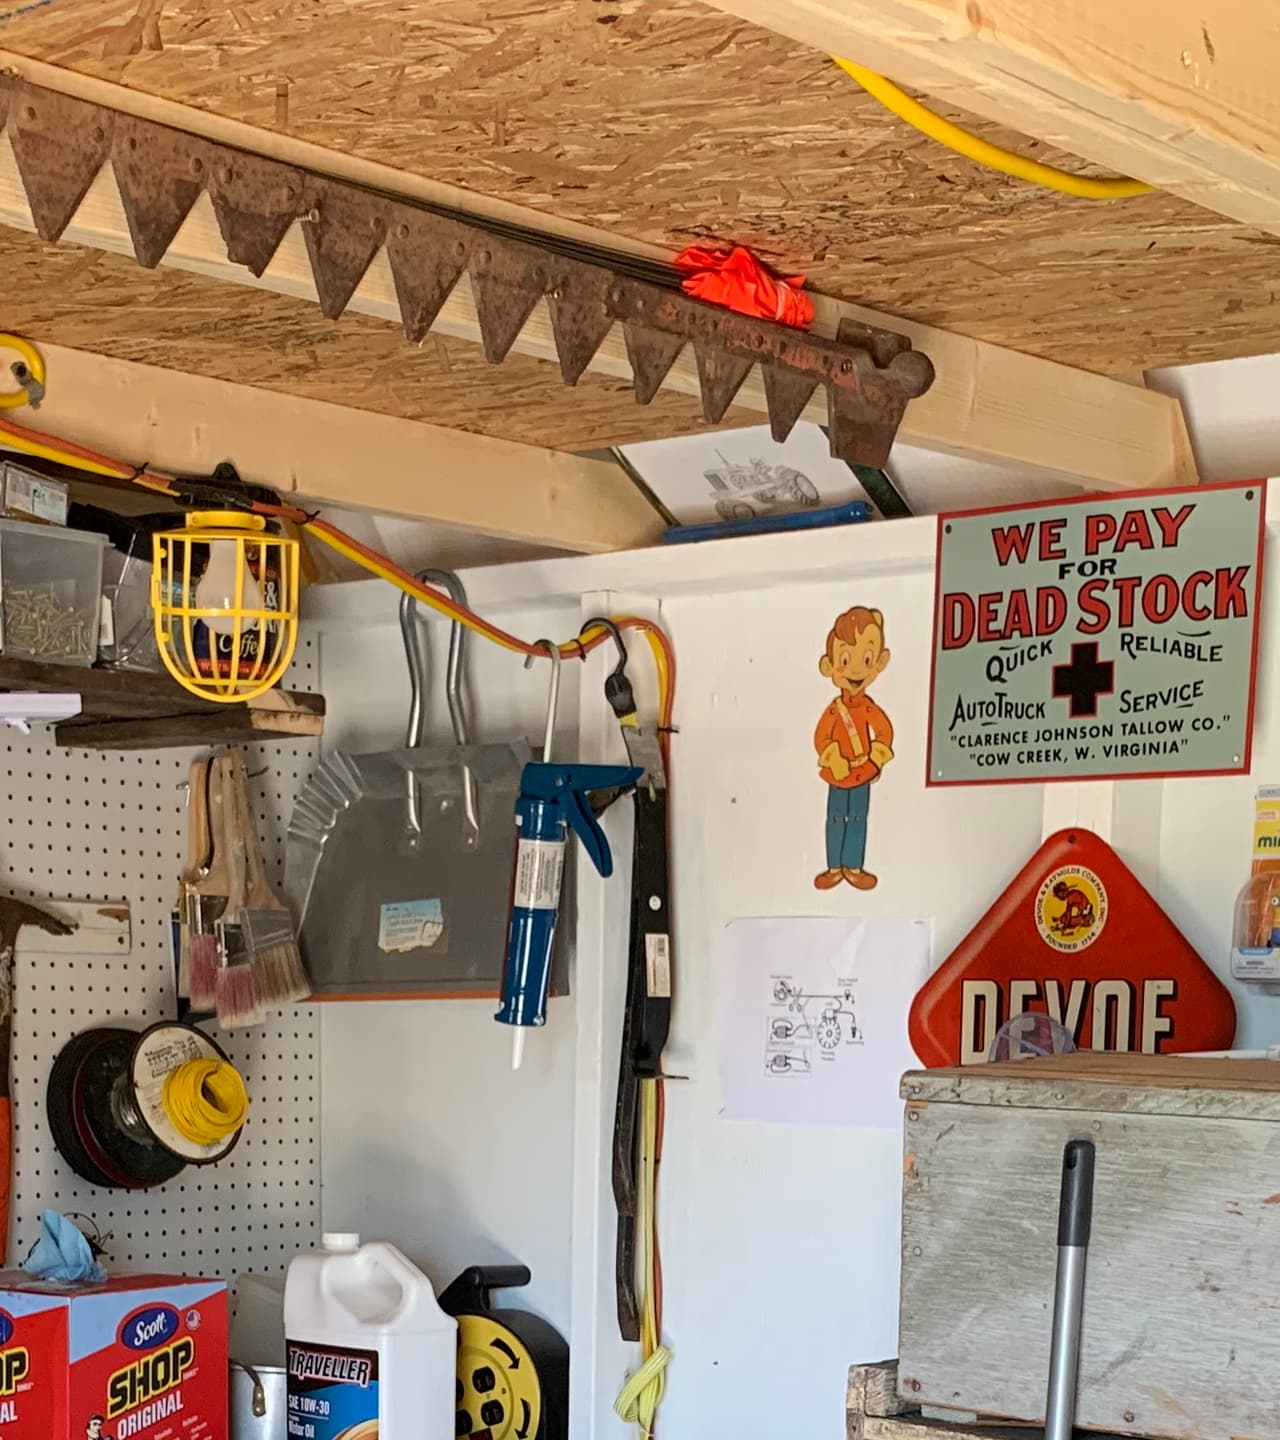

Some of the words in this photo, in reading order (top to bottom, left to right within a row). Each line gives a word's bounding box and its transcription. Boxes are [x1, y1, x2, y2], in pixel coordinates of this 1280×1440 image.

[991, 518, 1067, 566] WE
[1085, 504, 1197, 556] PAY
[1059, 558, 1117, 580] FOR
[941, 585, 1067, 651] DEAD
[1076, 565, 1251, 635] STOCK
[985, 640, 1053, 683] QUICK
[1120, 632, 1223, 662] RELIABLE
[1120, 680, 1204, 714] SERVICE
[950, 731, 1028, 748] "CLARENCE
[1034, 724, 1113, 742] JOHNSON
[1120, 720, 1185, 737] TALLOW
[969, 753, 1011, 767] "COW
[1016, 749, 1068, 765] CREEK,
[1074, 746, 1097, 760] W.
[1103, 739, 1188, 758] VIRGINIA"
[134, 1311, 167, 1346] Scott
[107, 1336, 194, 1420] SHOP
[289, 1348, 371, 1388] TRAVELLER
[117, 1390, 184, 1440] ORIGINAL
[288, 1394, 299, 1410] SAE
[300, 1397, 330, 1415] 10W-30
[288, 1421, 305, 1436] Motor
[305, 1424, 315, 1438] Oil
